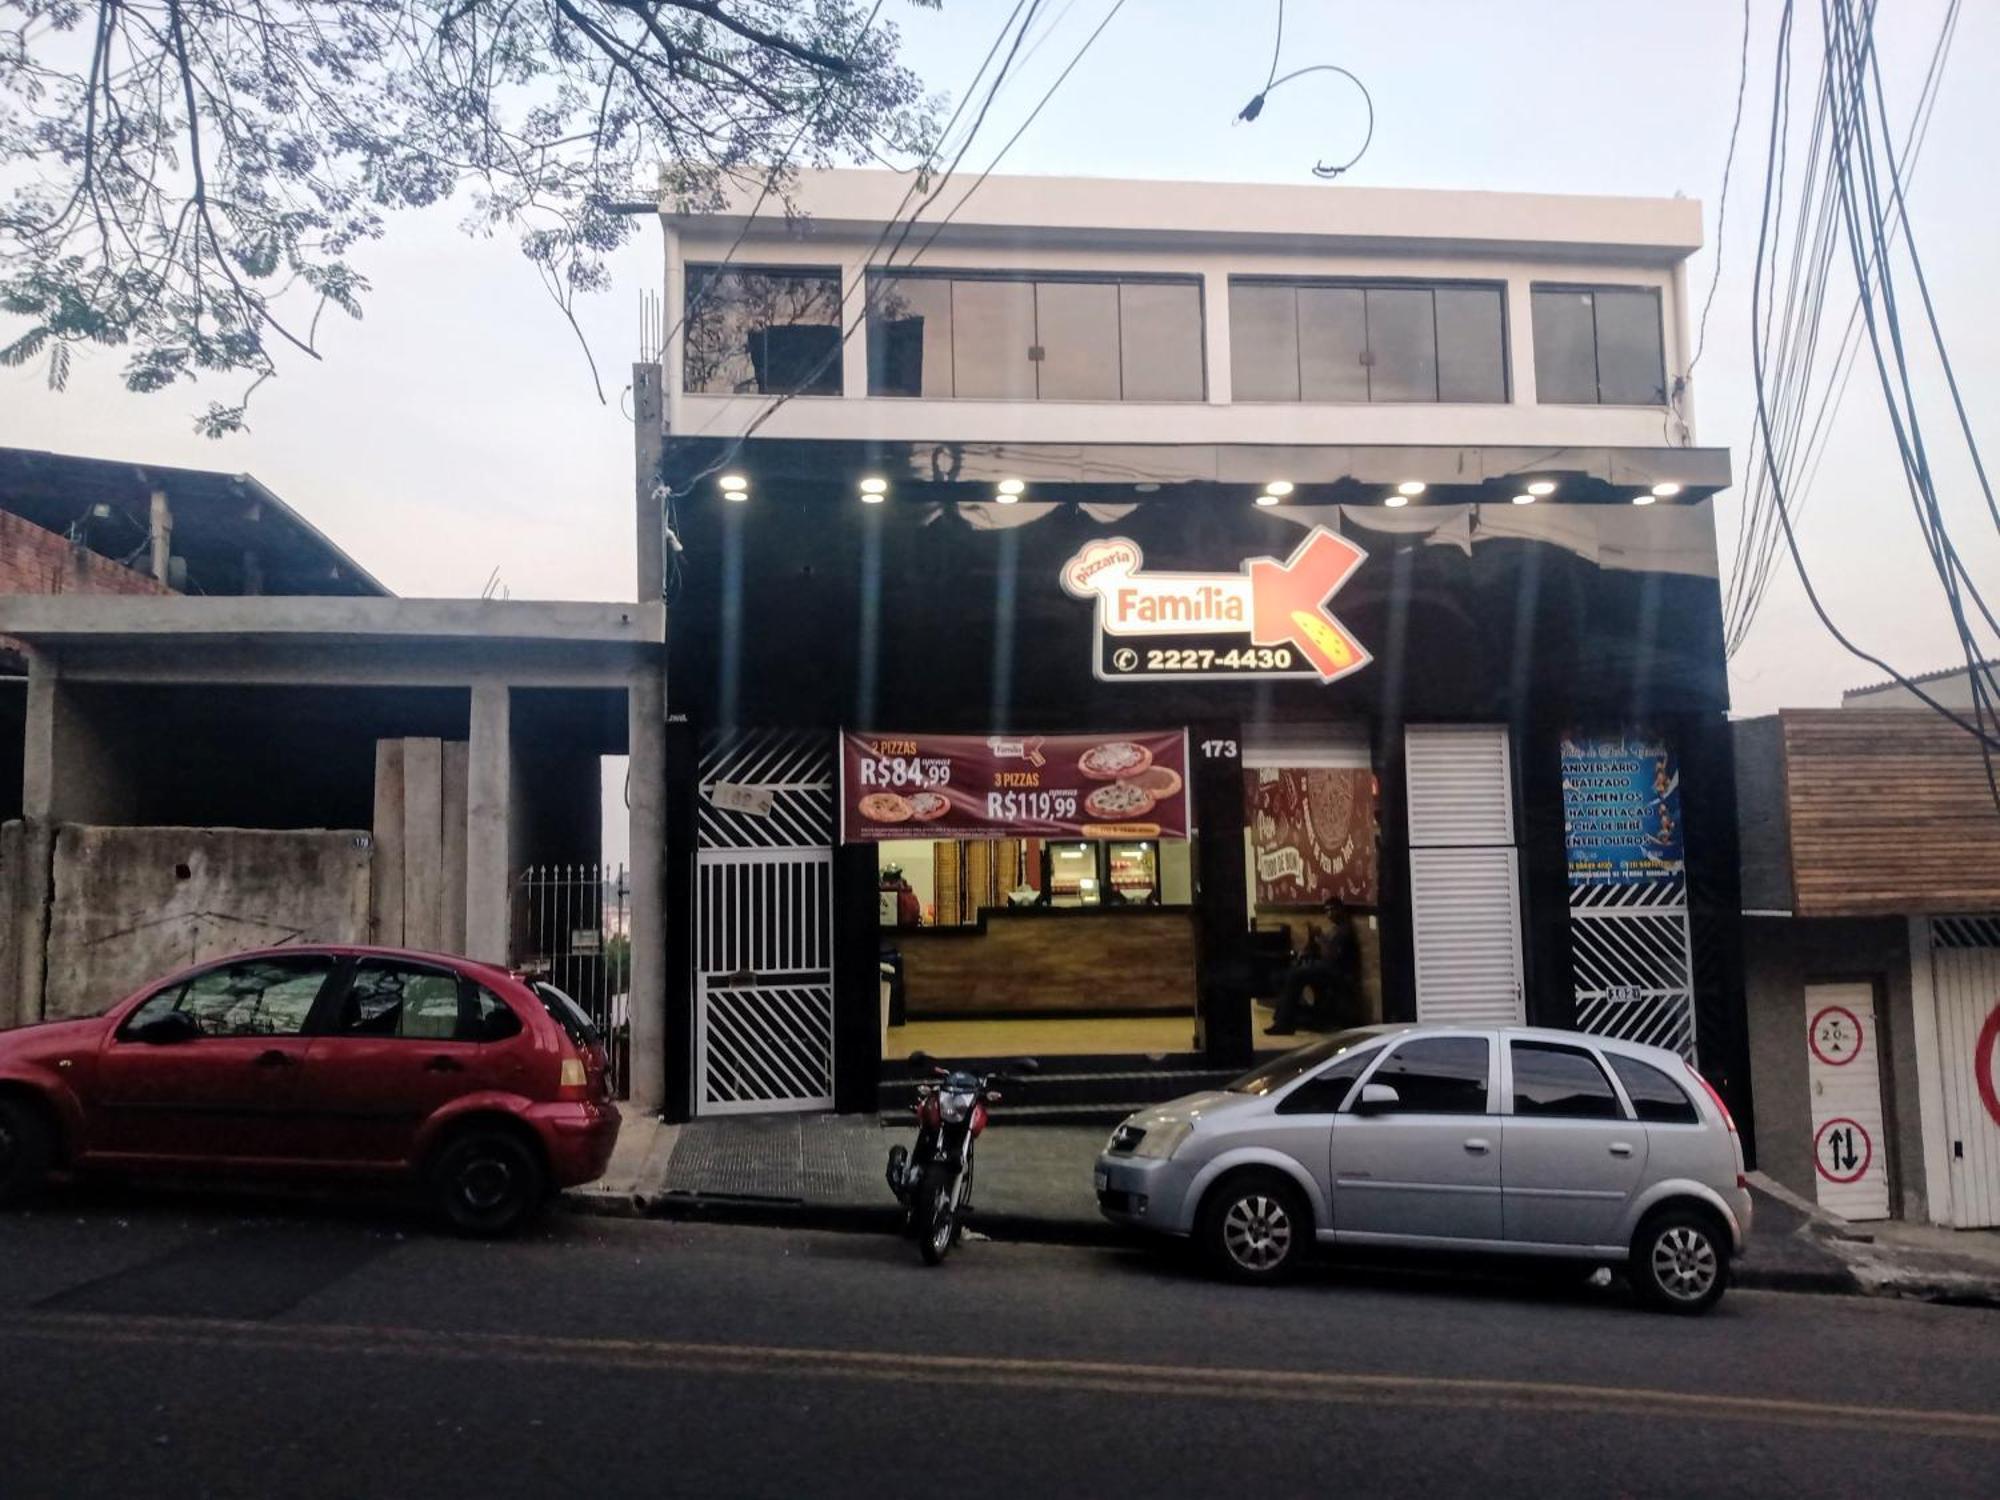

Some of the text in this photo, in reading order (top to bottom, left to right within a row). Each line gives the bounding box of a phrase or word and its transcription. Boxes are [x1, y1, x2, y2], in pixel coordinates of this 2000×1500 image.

[1076, 551, 1130, 585] pizzaria
[1147, 649, 1292, 670] 2227-4430
[871, 741, 917, 755] 2 PIZZAS
[1201, 740, 1237, 758] 173
[860, 756, 951, 789] R$84,99
[994, 772, 1040, 787] 3 PIZZAS
[987, 790, 1077, 822] R$119,99
